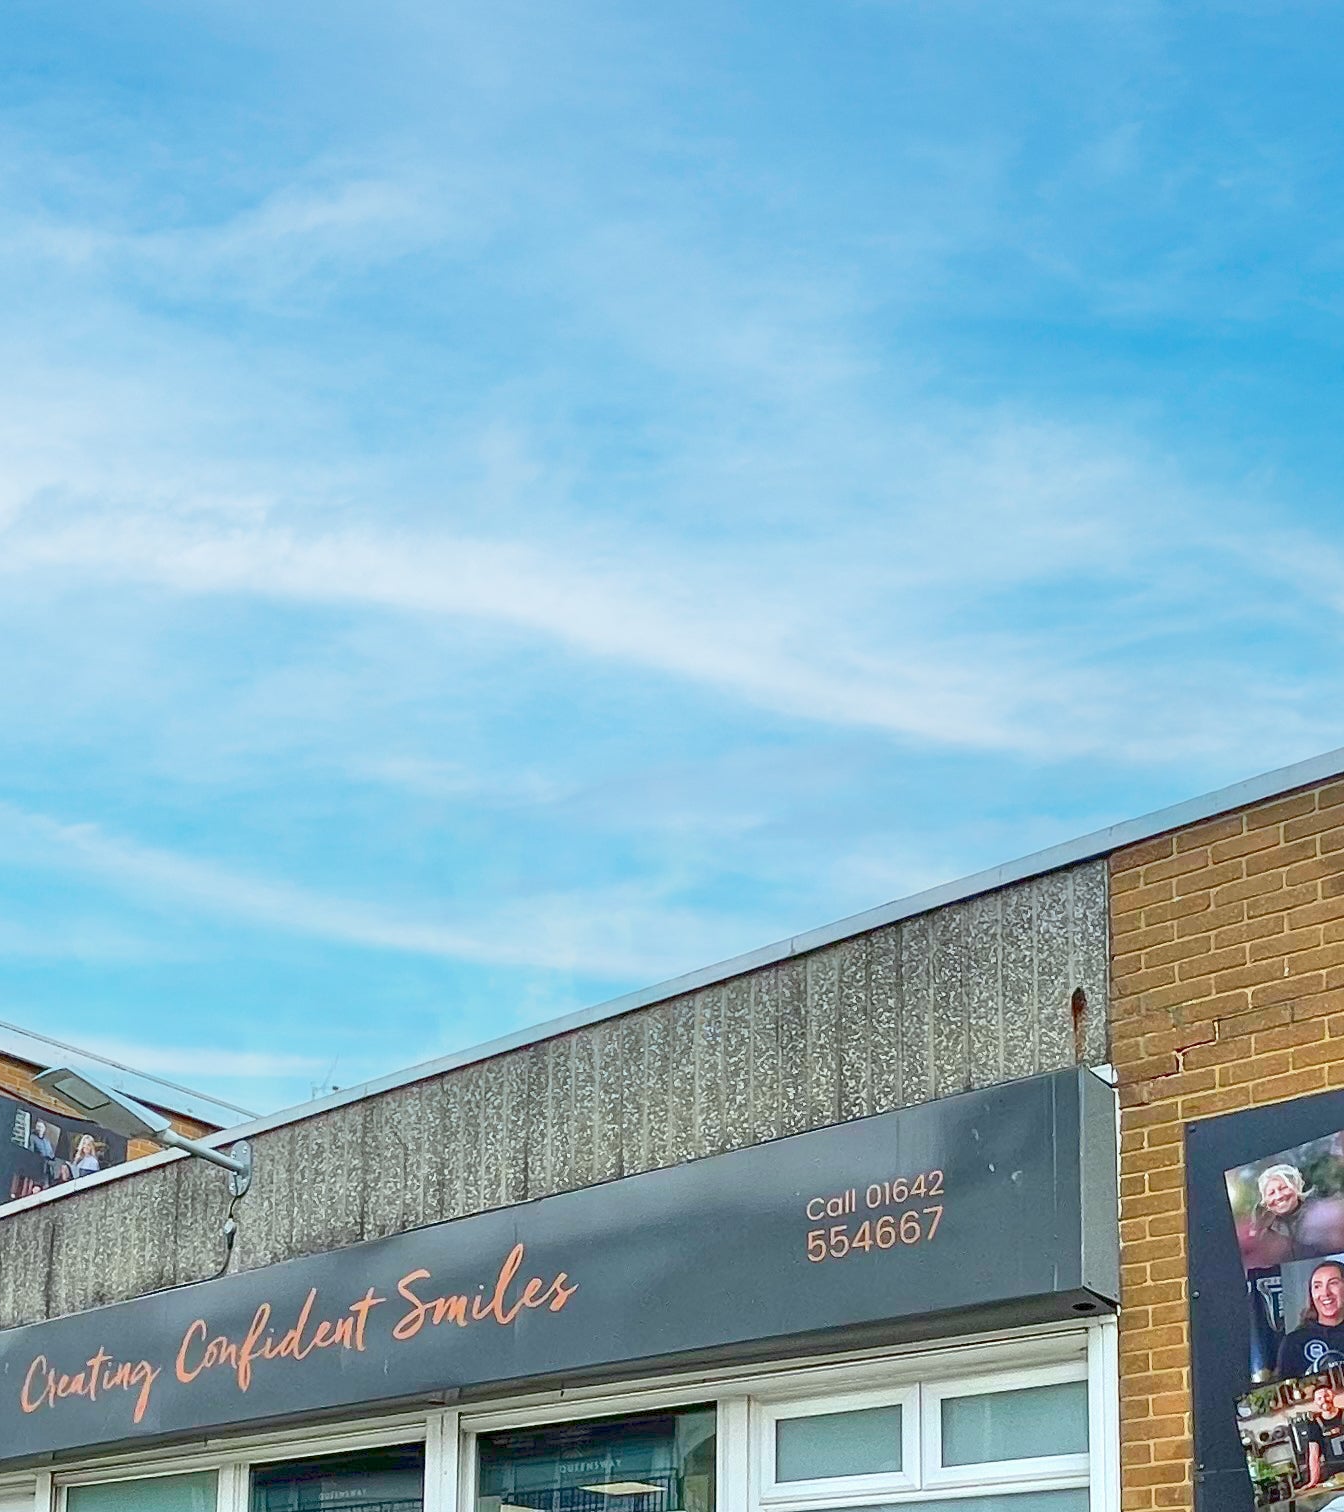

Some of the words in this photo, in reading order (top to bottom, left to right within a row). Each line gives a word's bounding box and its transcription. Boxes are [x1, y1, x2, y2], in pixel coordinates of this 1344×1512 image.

[806, 1188, 856, 1220] Call
[866, 1170, 944, 1209] 01642
[807, 1205, 944, 1262] 554667
[19, 1347, 161, 1423] Creating
[175, 1287, 386, 1392] Confident
[391, 1242, 579, 1340] Smiles
[559, 1459, 623, 1474] QUEENSWAY
